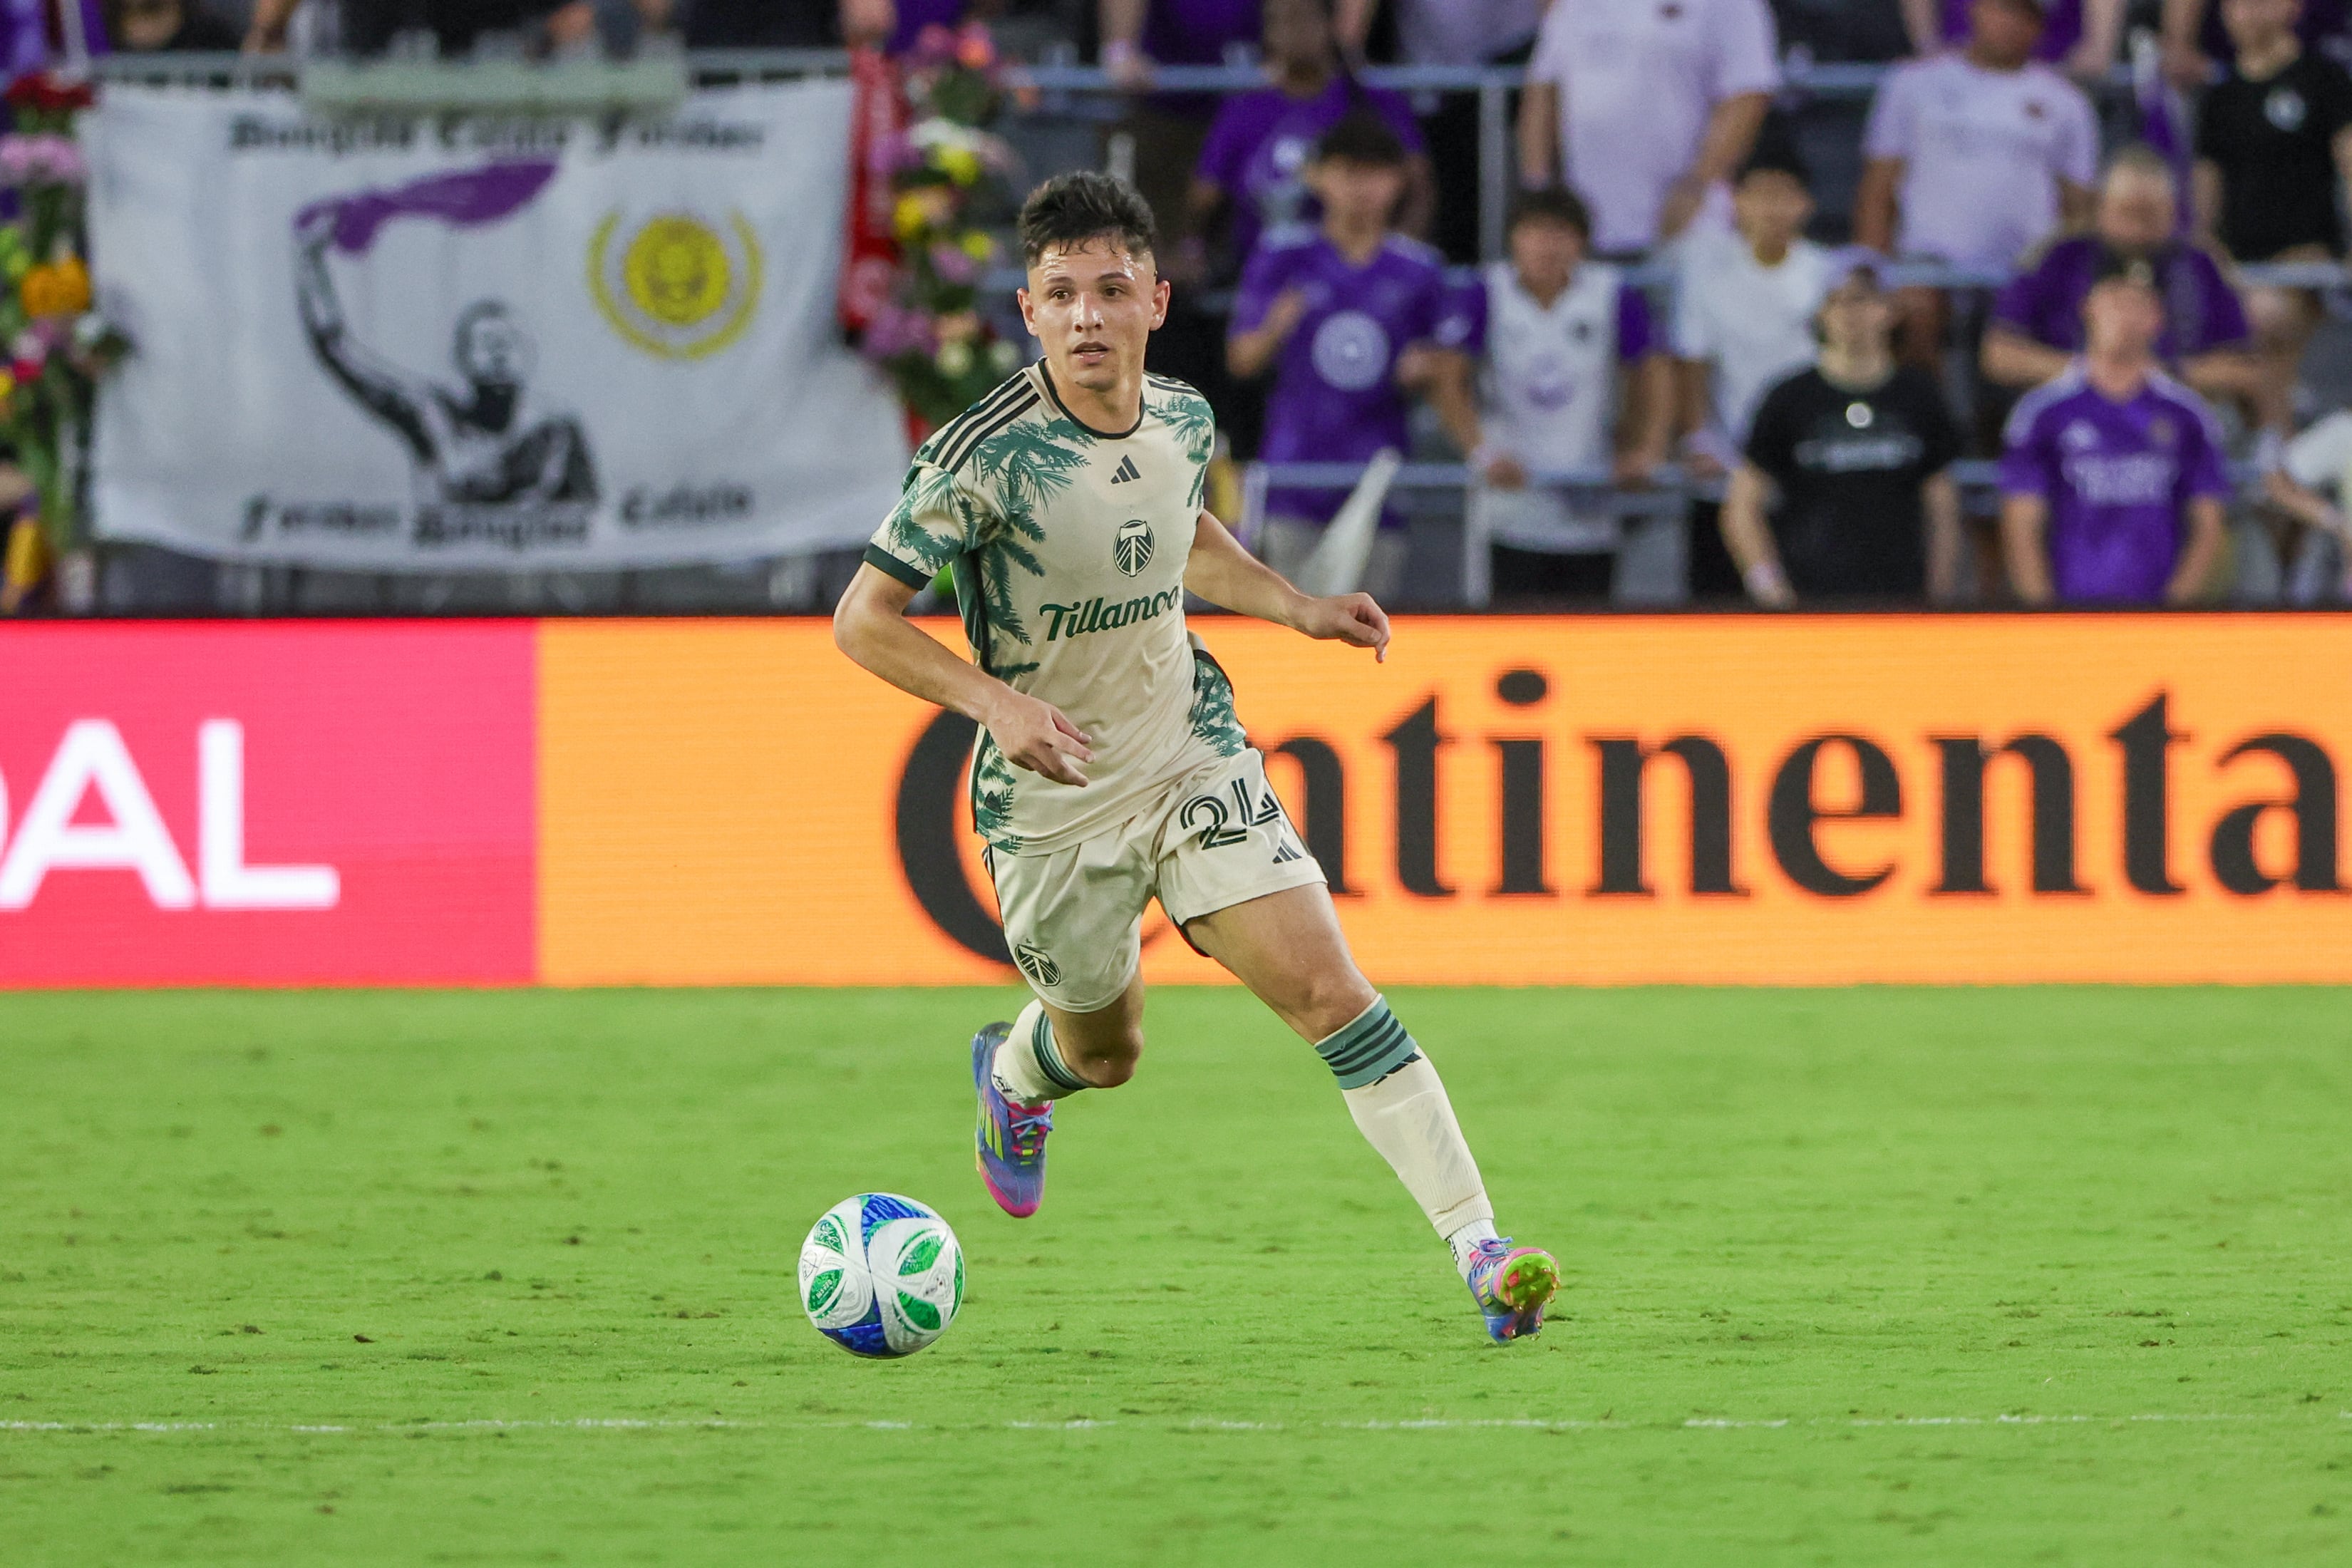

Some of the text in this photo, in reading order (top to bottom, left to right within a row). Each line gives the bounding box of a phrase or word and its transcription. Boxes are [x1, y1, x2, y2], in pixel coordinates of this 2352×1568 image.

[1039, 585, 1180, 641] Tillamoo
[0, 718, 341, 911] AL
[1180, 778, 1280, 850] 24
